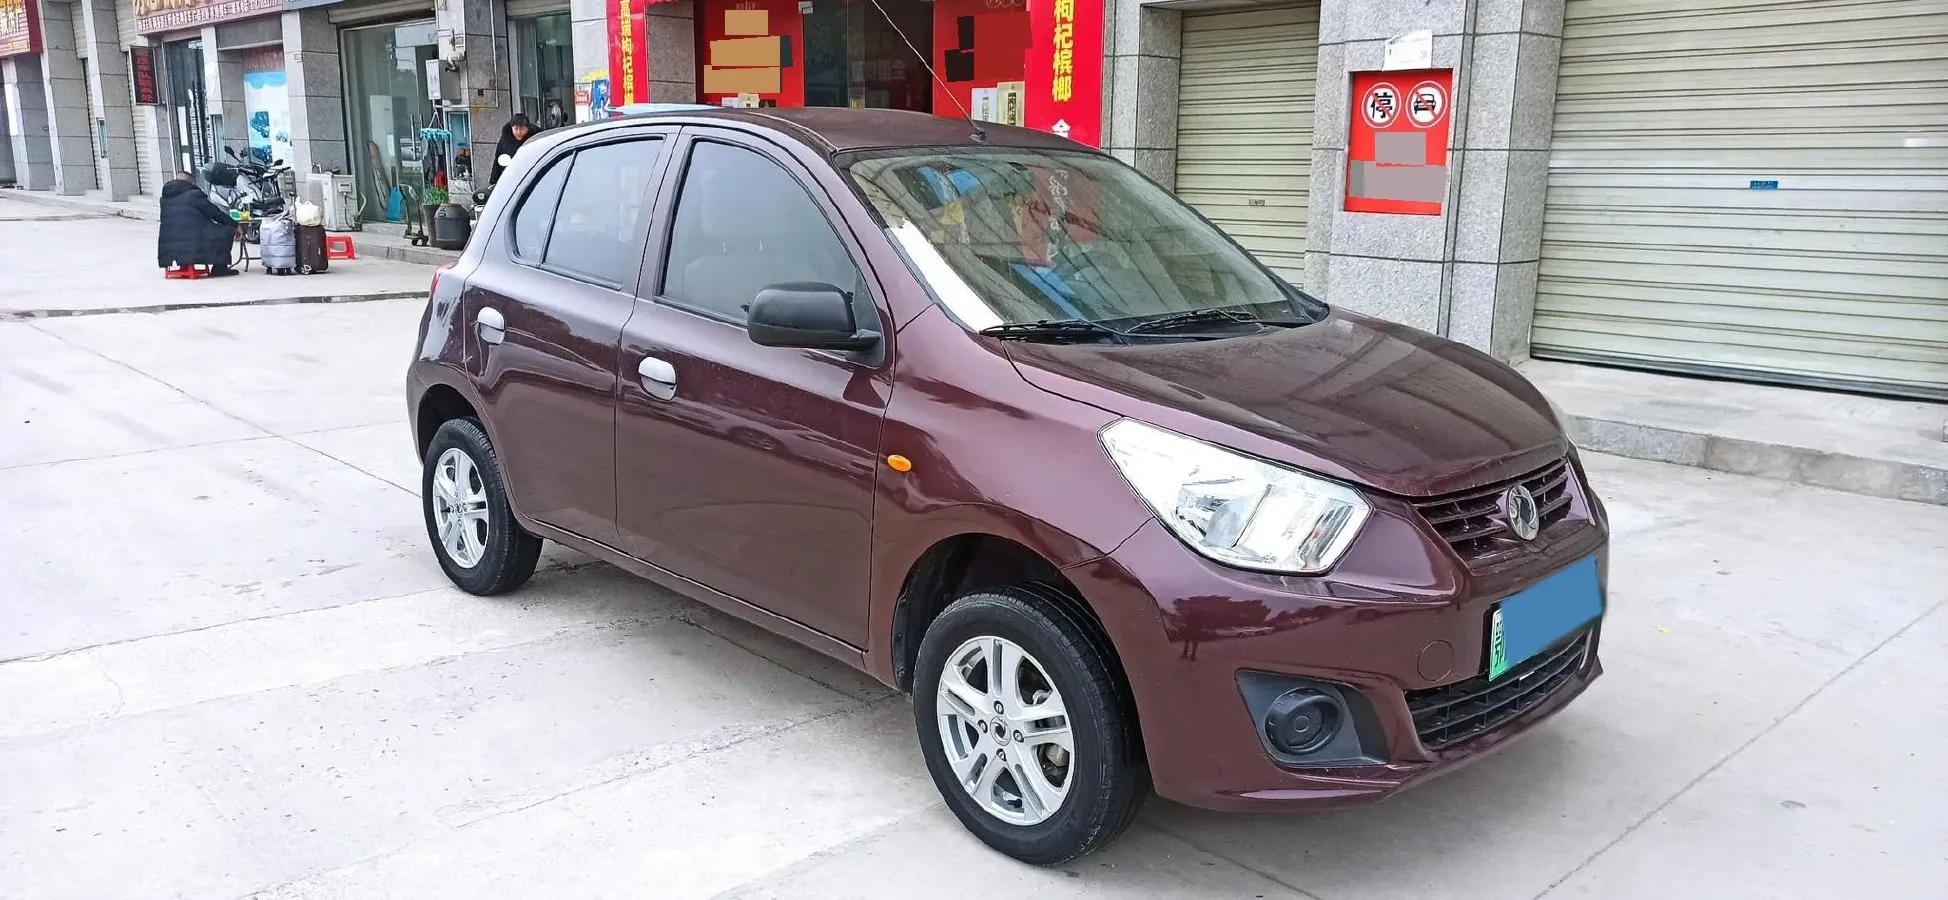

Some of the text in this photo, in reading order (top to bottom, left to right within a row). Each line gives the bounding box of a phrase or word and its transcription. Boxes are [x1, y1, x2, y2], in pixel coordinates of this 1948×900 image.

[1051, 0, 1076, 103] 枸杞槟榔
[1370, 91, 1393, 119] 停
